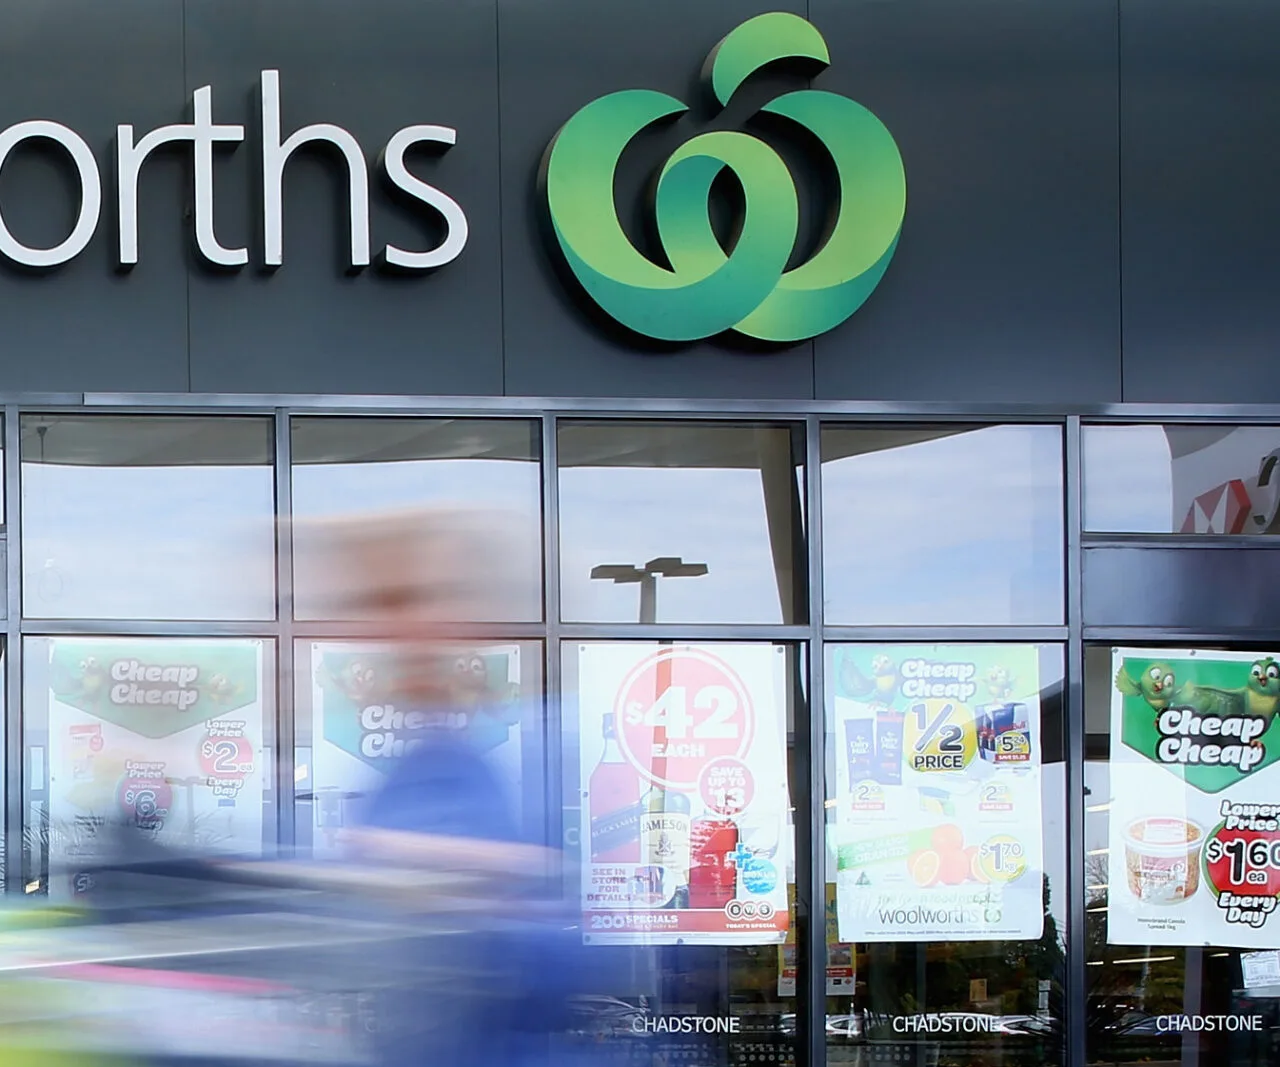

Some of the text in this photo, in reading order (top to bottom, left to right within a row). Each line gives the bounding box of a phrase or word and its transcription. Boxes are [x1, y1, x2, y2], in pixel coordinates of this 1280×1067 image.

[111, 660, 198, 688] Cheap
[902, 659, 974, 682] Cheap
[111, 683, 198, 710] Cheap
[902, 680, 975, 702] Cheap
[625, 685, 739, 739] $42
[1159, 709, 1265, 744] Cheap
[652, 743, 706, 758] EACH
[1158, 737, 1264, 771] Cheap
[914, 755, 963, 768] PRICE
[1225, 815, 1278, 831] Price
[1219, 892, 1277, 913] Every
[591, 914, 626, 929] 200
[625, 915, 679, 923] SPECIALS
[1227, 907, 1266, 927] Day
[632, 1016, 741, 1034] CHADSTONE
[892, 1015, 1000, 1033] CHADSTONE
[1156, 1014, 1263, 1031] CHADSTONE
